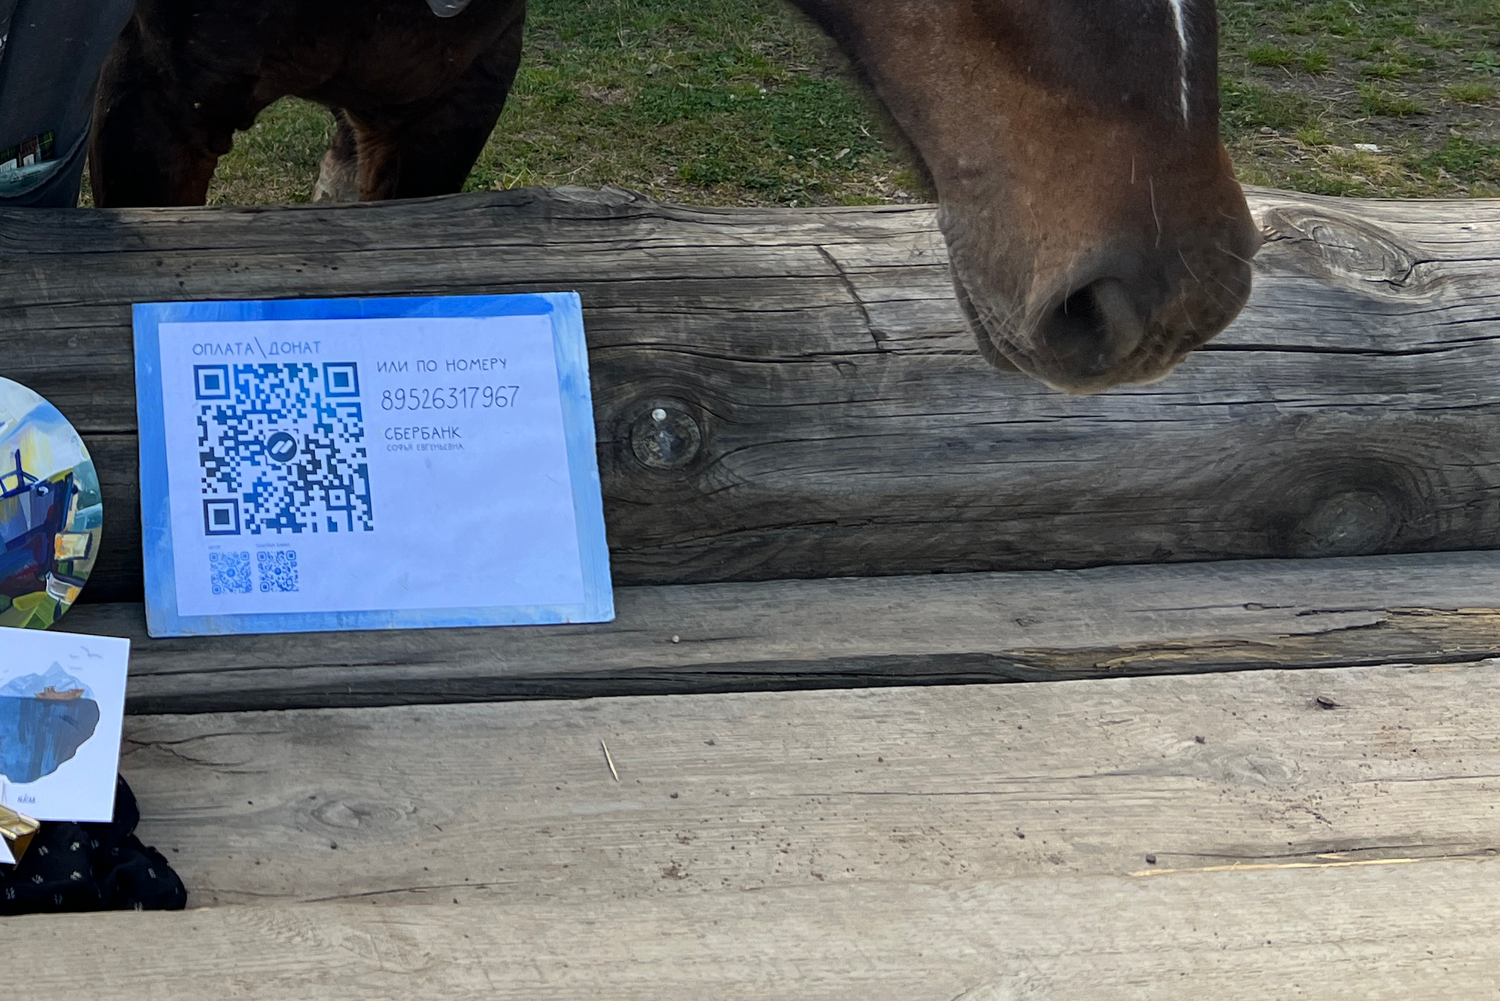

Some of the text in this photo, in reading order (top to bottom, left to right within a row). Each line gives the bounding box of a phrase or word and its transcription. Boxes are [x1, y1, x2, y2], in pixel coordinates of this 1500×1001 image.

[376, 357, 508, 373] ИЛИ ПО НОМЕРУ
[381, 385, 520, 411] 89526317967
[384, 426, 462, 441] СБЕРБАНК
[386, 442, 464, 452] СОФЬЯ ЕВГЕНЬЕВНА
